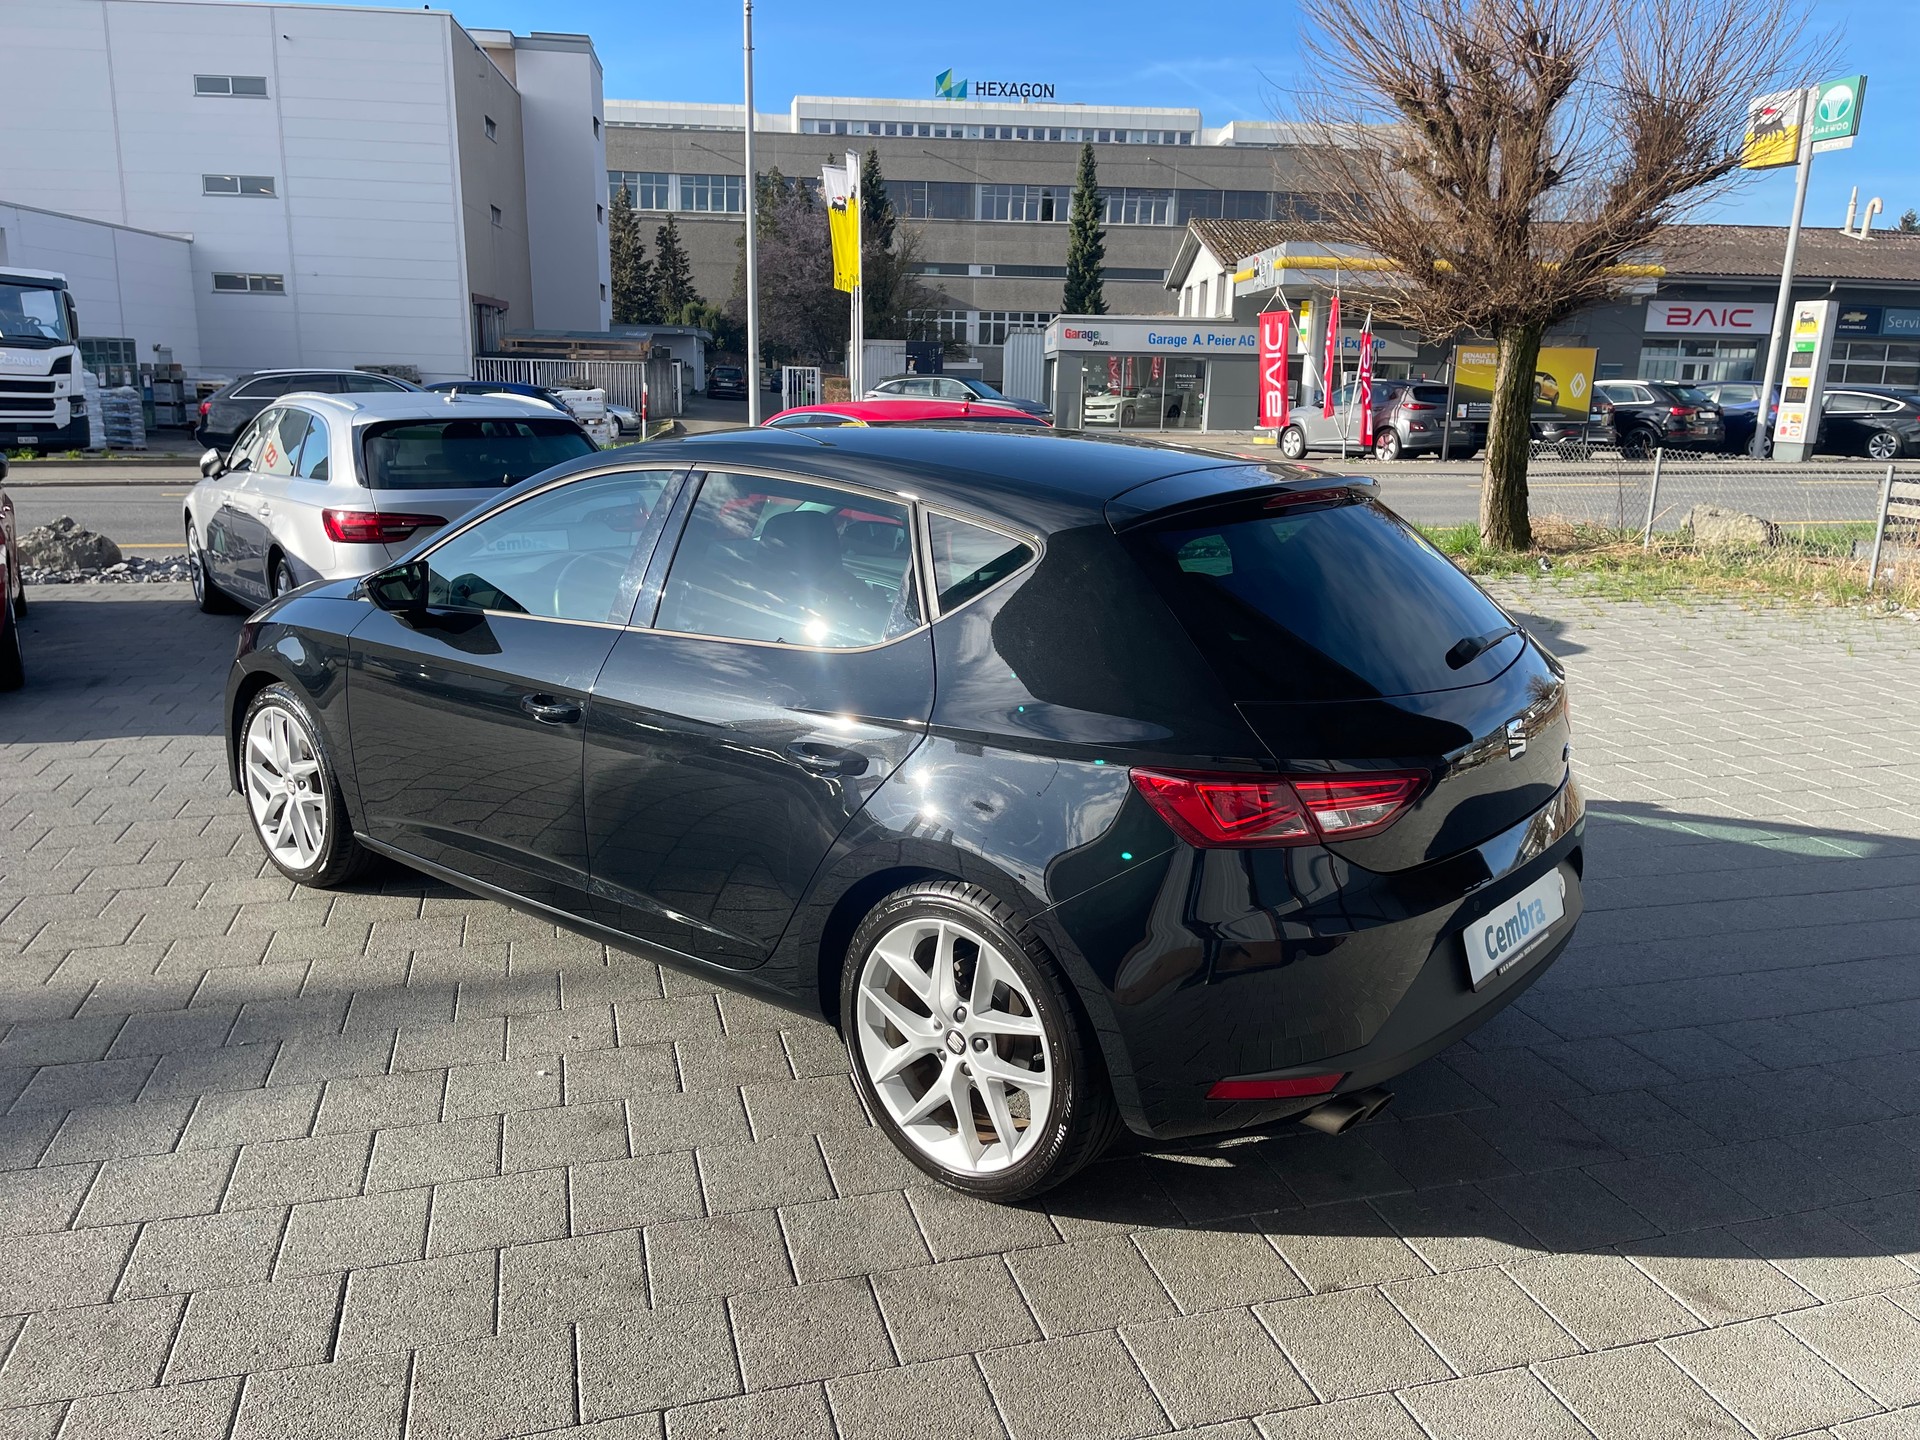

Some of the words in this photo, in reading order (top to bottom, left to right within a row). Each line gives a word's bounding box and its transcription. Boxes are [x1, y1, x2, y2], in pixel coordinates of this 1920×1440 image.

[975, 81, 1055, 98] HEXAGON
[1666, 307, 1754, 328] BAIC
[1064, 328, 1099, 342] Garage
[1148, 332, 1188, 348] Garage
[1192, 333, 1204, 345] A.
[1207, 333, 1236, 346] Peier
[1238, 334, 1255, 346] AG
[1264, 322, 1283, 418] BAIC
[1484, 898, 1546, 961] Cembra
